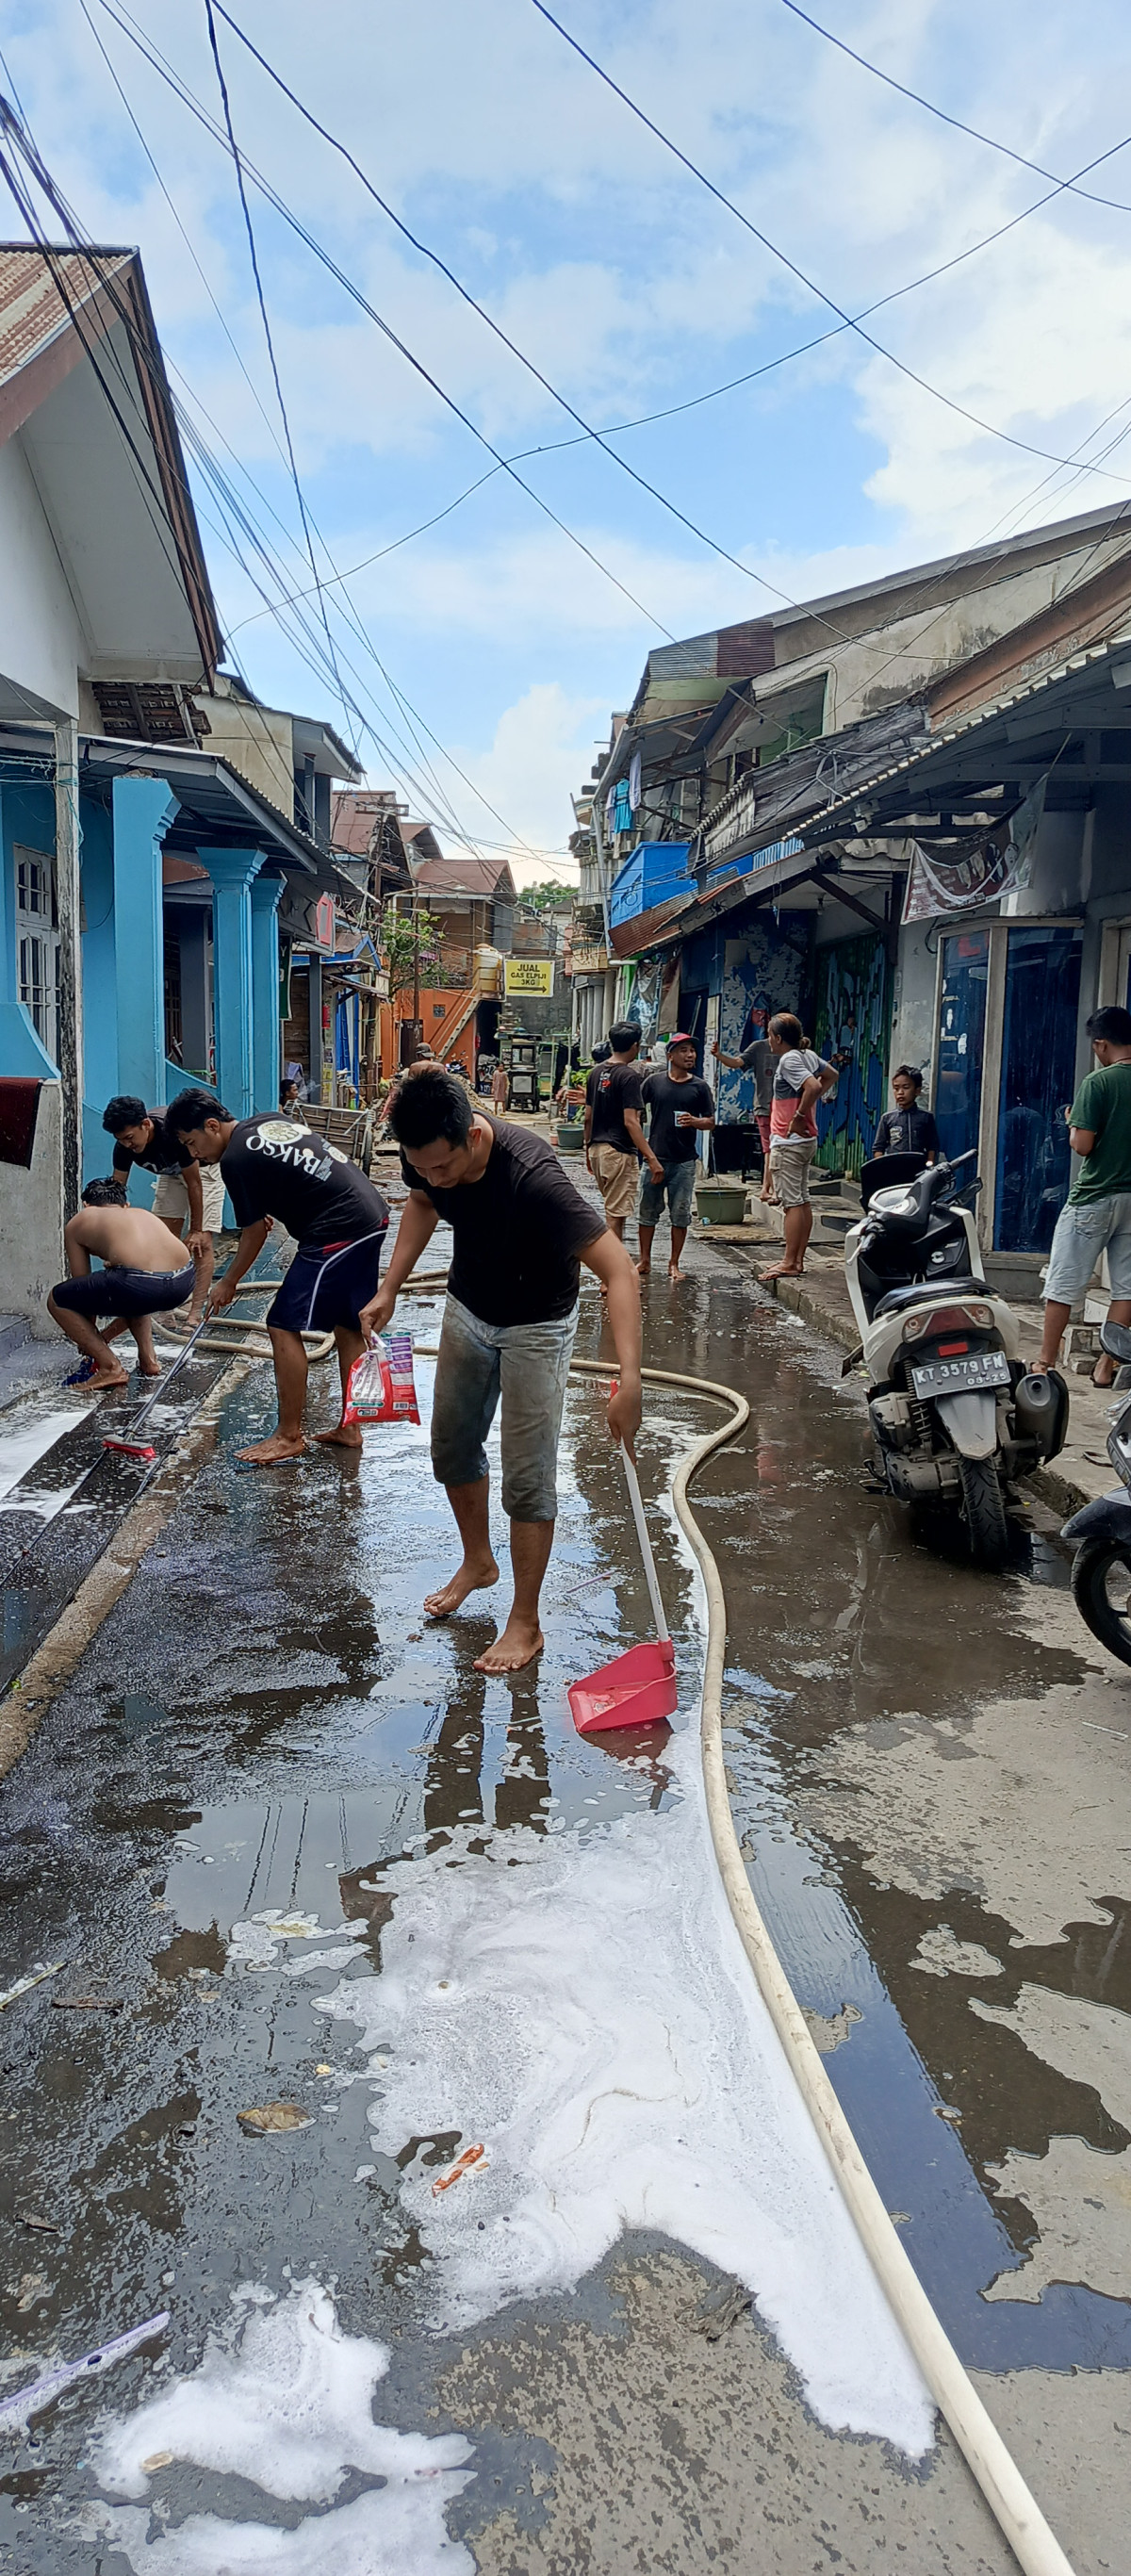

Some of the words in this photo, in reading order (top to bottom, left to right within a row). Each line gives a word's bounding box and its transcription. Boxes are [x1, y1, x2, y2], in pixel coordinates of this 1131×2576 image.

[517, 964, 540, 973] JUAL
[246, 1135, 321, 1175] BAKSO
[915, 1368, 935, 1384] KT
[940, 1360, 979, 1377] 3579
